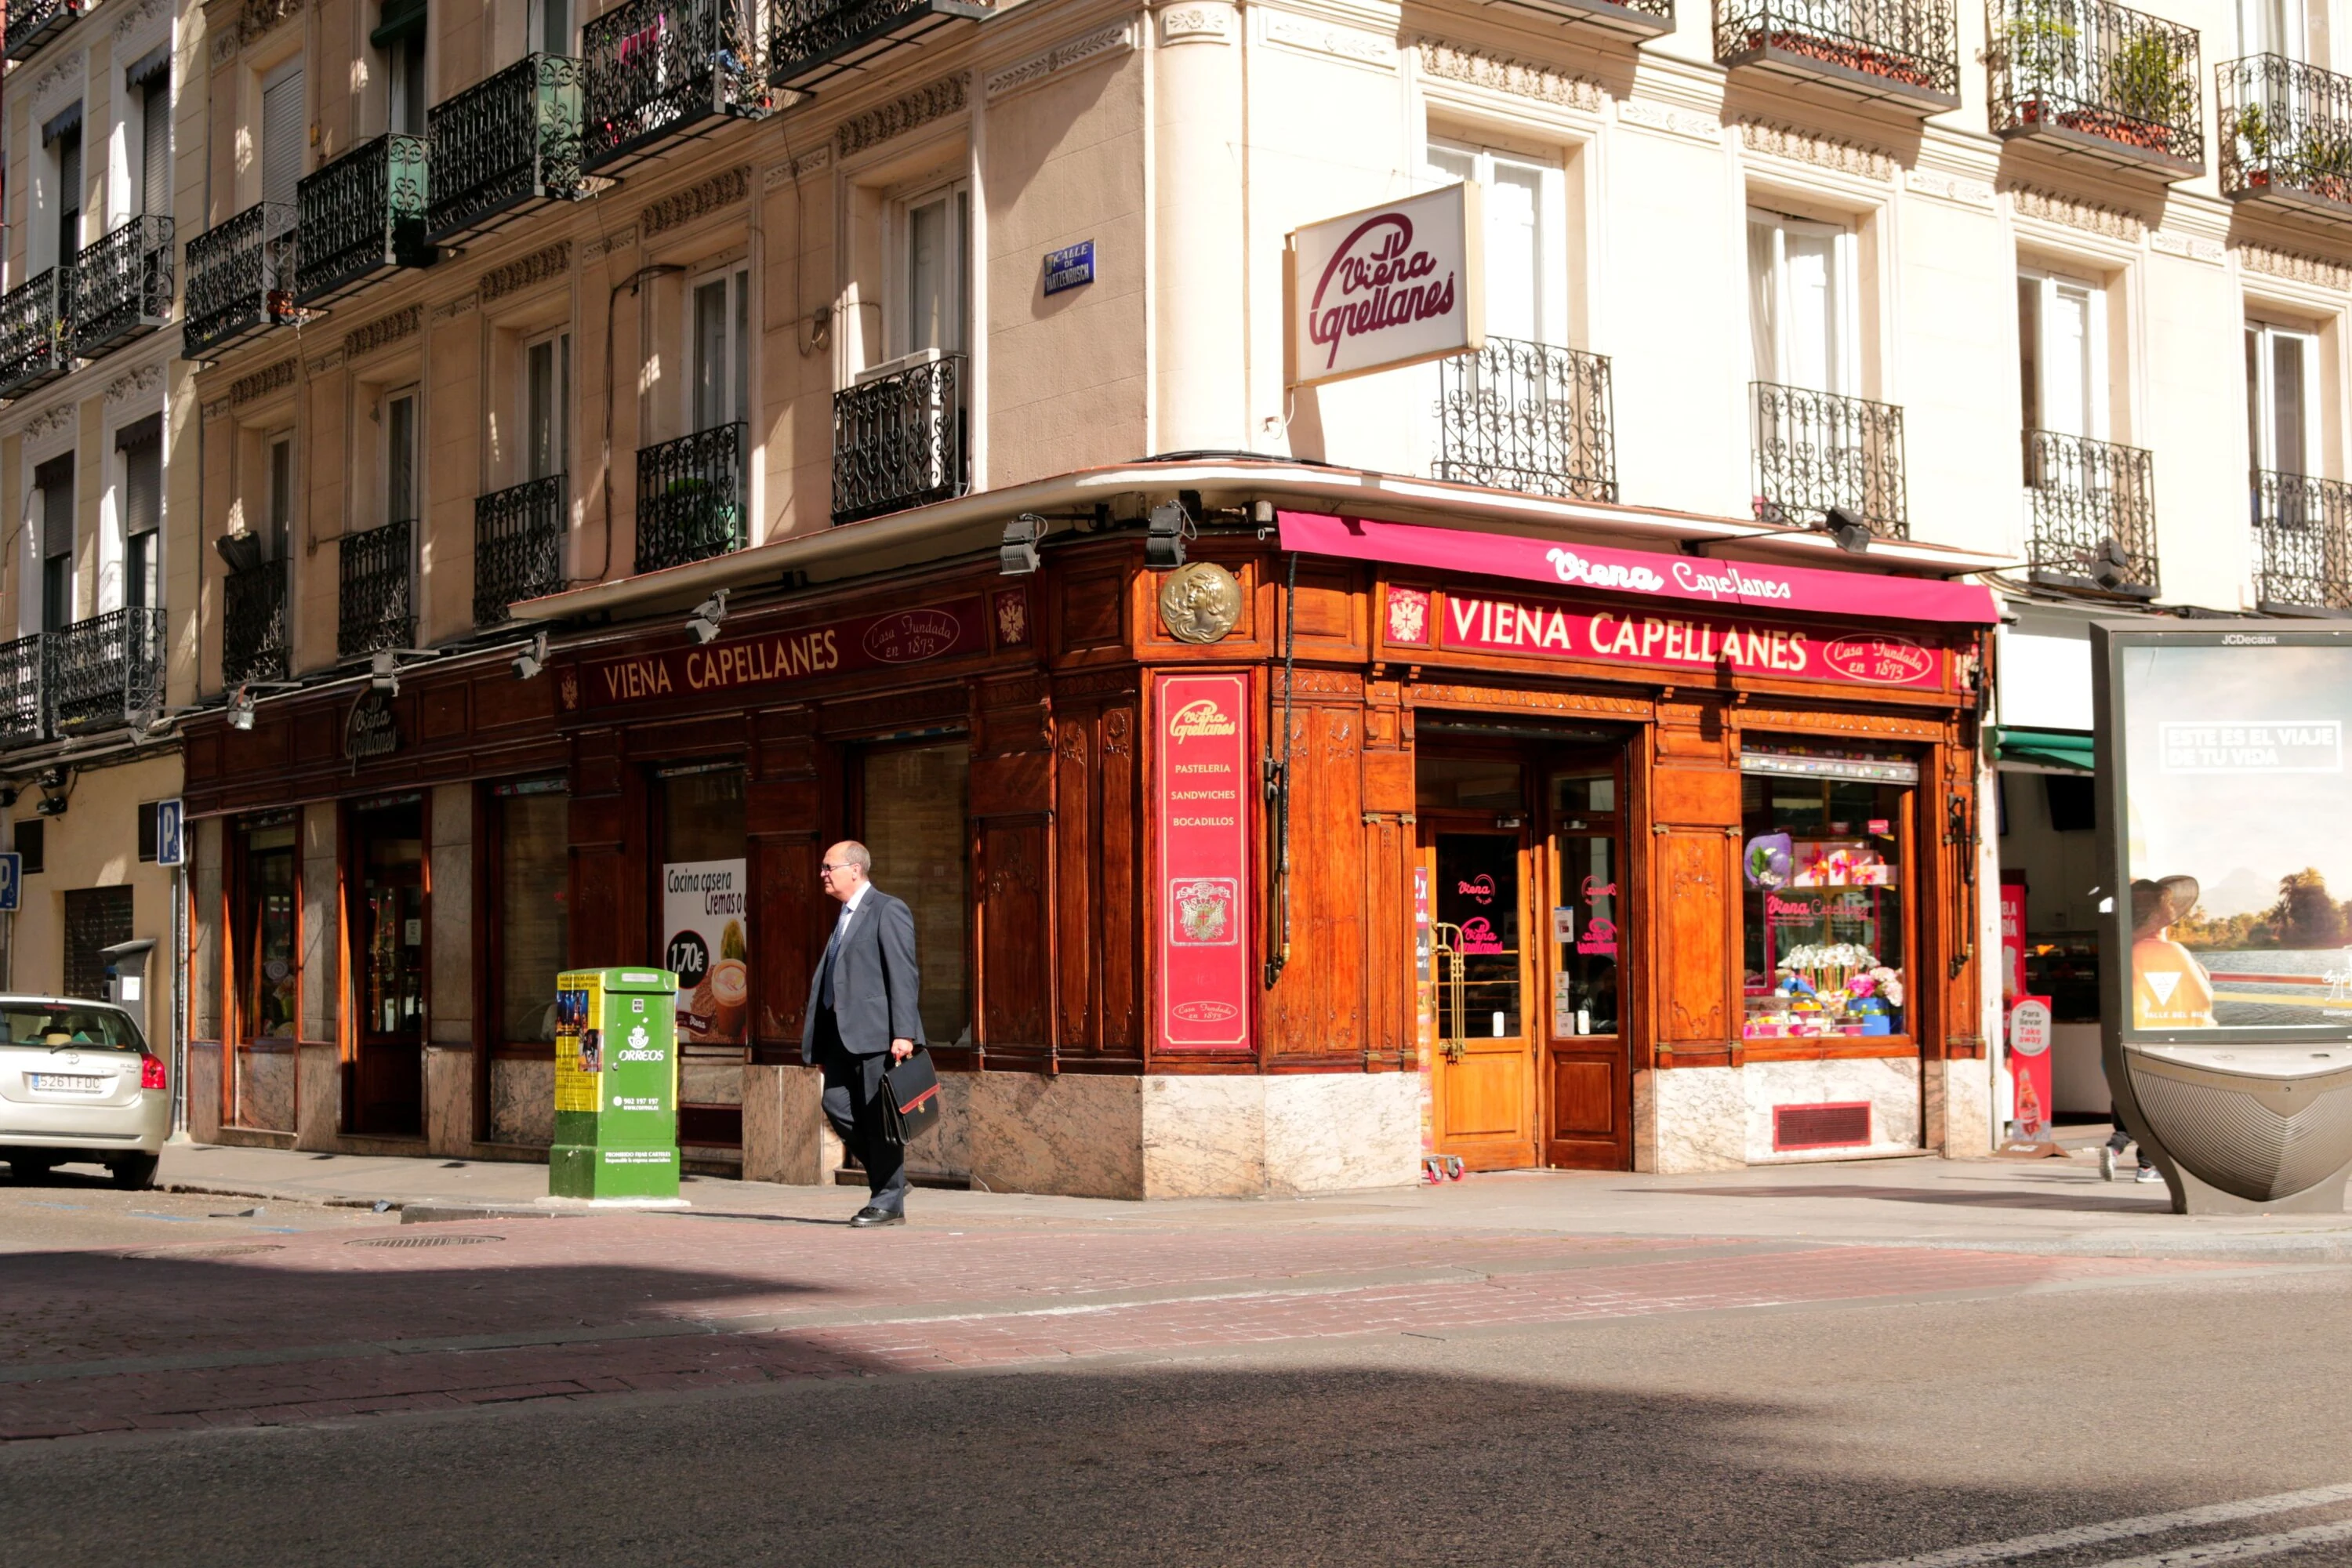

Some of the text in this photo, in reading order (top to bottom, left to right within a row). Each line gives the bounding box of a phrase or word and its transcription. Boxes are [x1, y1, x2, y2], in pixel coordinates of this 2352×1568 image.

[1055, 244, 1088, 263] CALLE
[1064, 259, 1074, 268] DE
[1046, 263, 1090, 291] HARTZENBUSCH
[1339, 251, 1437, 296] Viena
[1309, 212, 1454, 370] Capellanes
[1545, 547, 1791, 600] Viena Capellanes
[871, 614, 952, 648] Casa Fundada
[1450, 597, 1809, 672] VIENA CAPELLANES
[2221, 634, 2277, 645] JCDecaux
[885, 636, 935, 658] en 1873
[1834, 638, 1923, 672] Casa Fundada
[604, 629, 840, 700] VIENA CAPELLANES
[1849, 659, 1904, 680] en 1873
[355, 710, 391, 731] Viena
[1170, 699, 1236, 745] Capellanes
[1183, 710, 1228, 724] Viena
[2168, 728, 2335, 746] ESTE ES EL VIAJE
[2168, 749, 2280, 766] DE TU VIDA
[1174, 764, 1232, 774] PASTELERIA
[1171, 790, 1236, 800] SANDWICHES
[162, 806, 175, 858] P
[1173, 817, 1234, 826] BOCADILLOS
[668, 868, 732, 894] Cocina casera
[1458, 880, 1490, 895] Viena
[706, 891, 735, 916] Cremas
[737, 897, 742, 914] o
[1766, 895, 1810, 915] Viena
[1465, 927, 1497, 942] Viena
[671, 942, 704, 974] 1,70€
[1178, 1003, 1232, 1015] Casa Fundada
[41, 1076, 100, 1089] 5261 FDC
